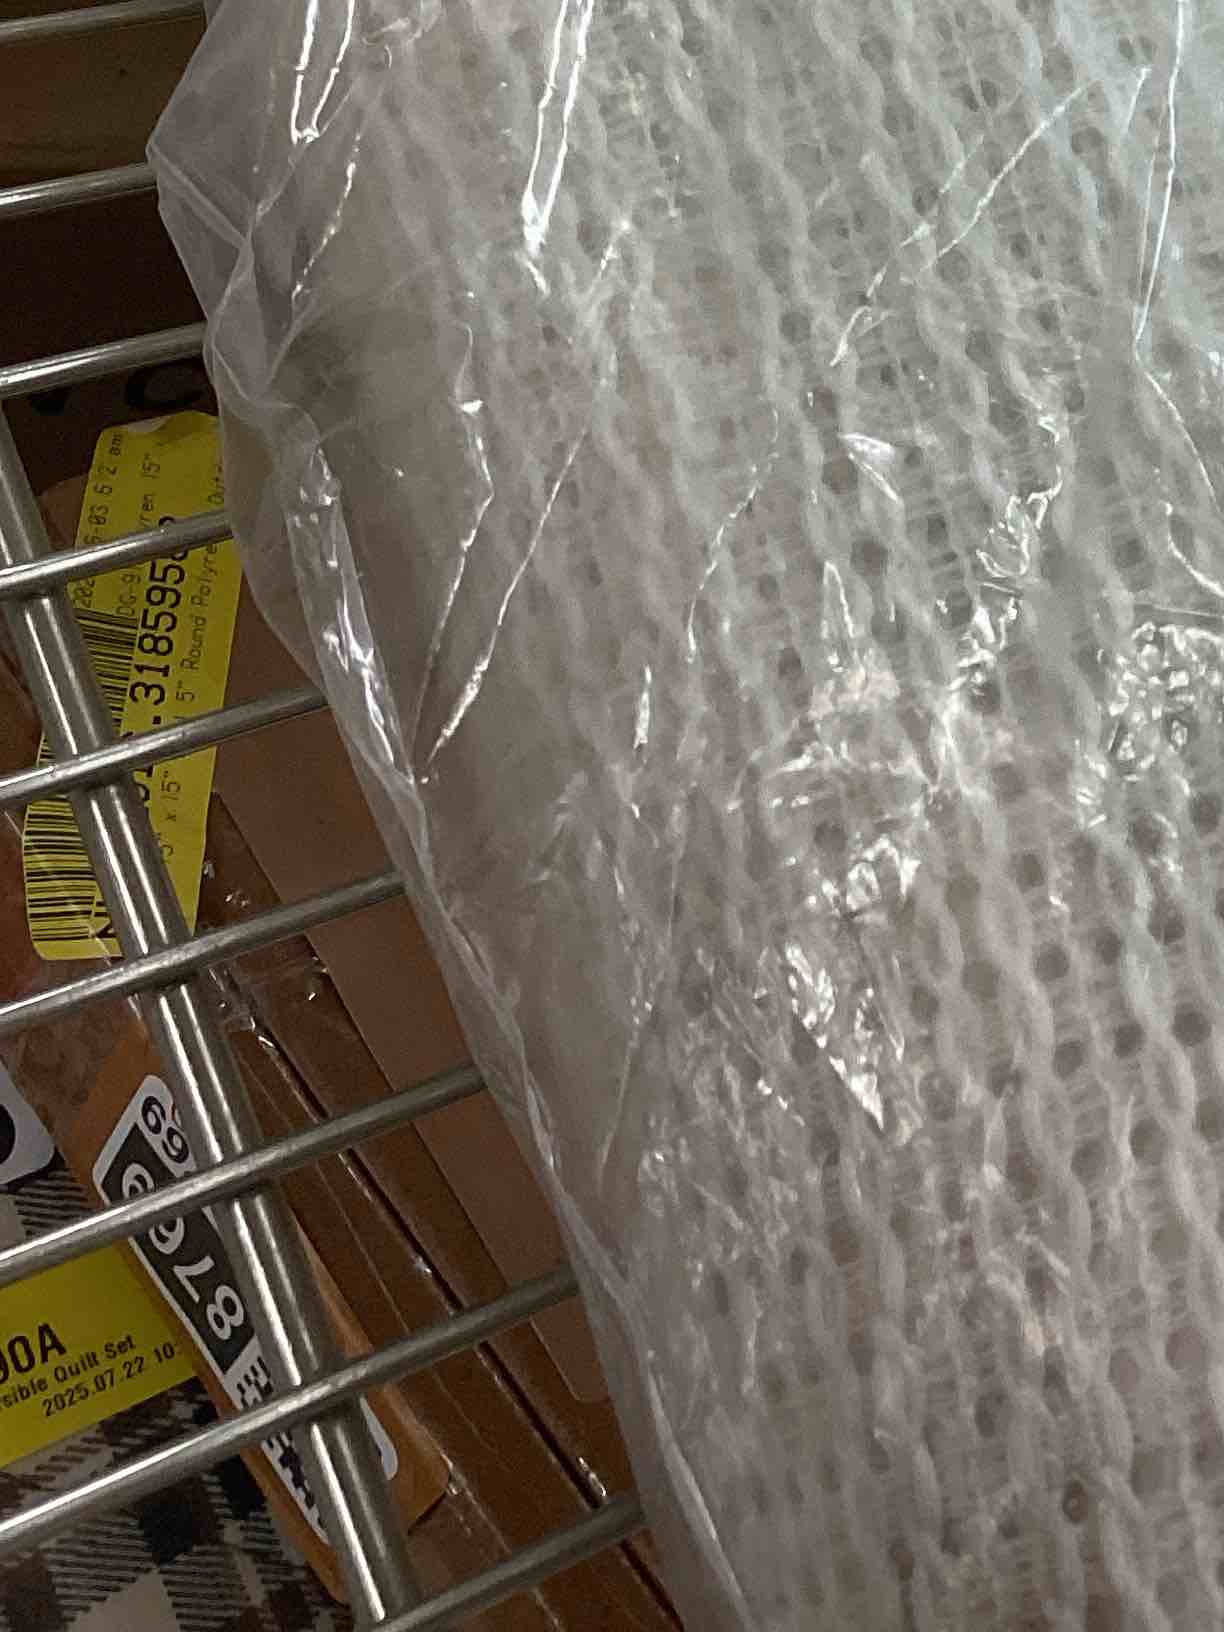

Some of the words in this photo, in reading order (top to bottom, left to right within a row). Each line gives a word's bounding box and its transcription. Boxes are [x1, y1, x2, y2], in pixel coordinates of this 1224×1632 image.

[190, 543, 218, 608] Polyre
[182, 616, 207, 671] Round
[0, 1377, 48, 1412] sible
[54, 1351, 100, 1383] Quilt
[104, 1334, 136, 1359] Set
